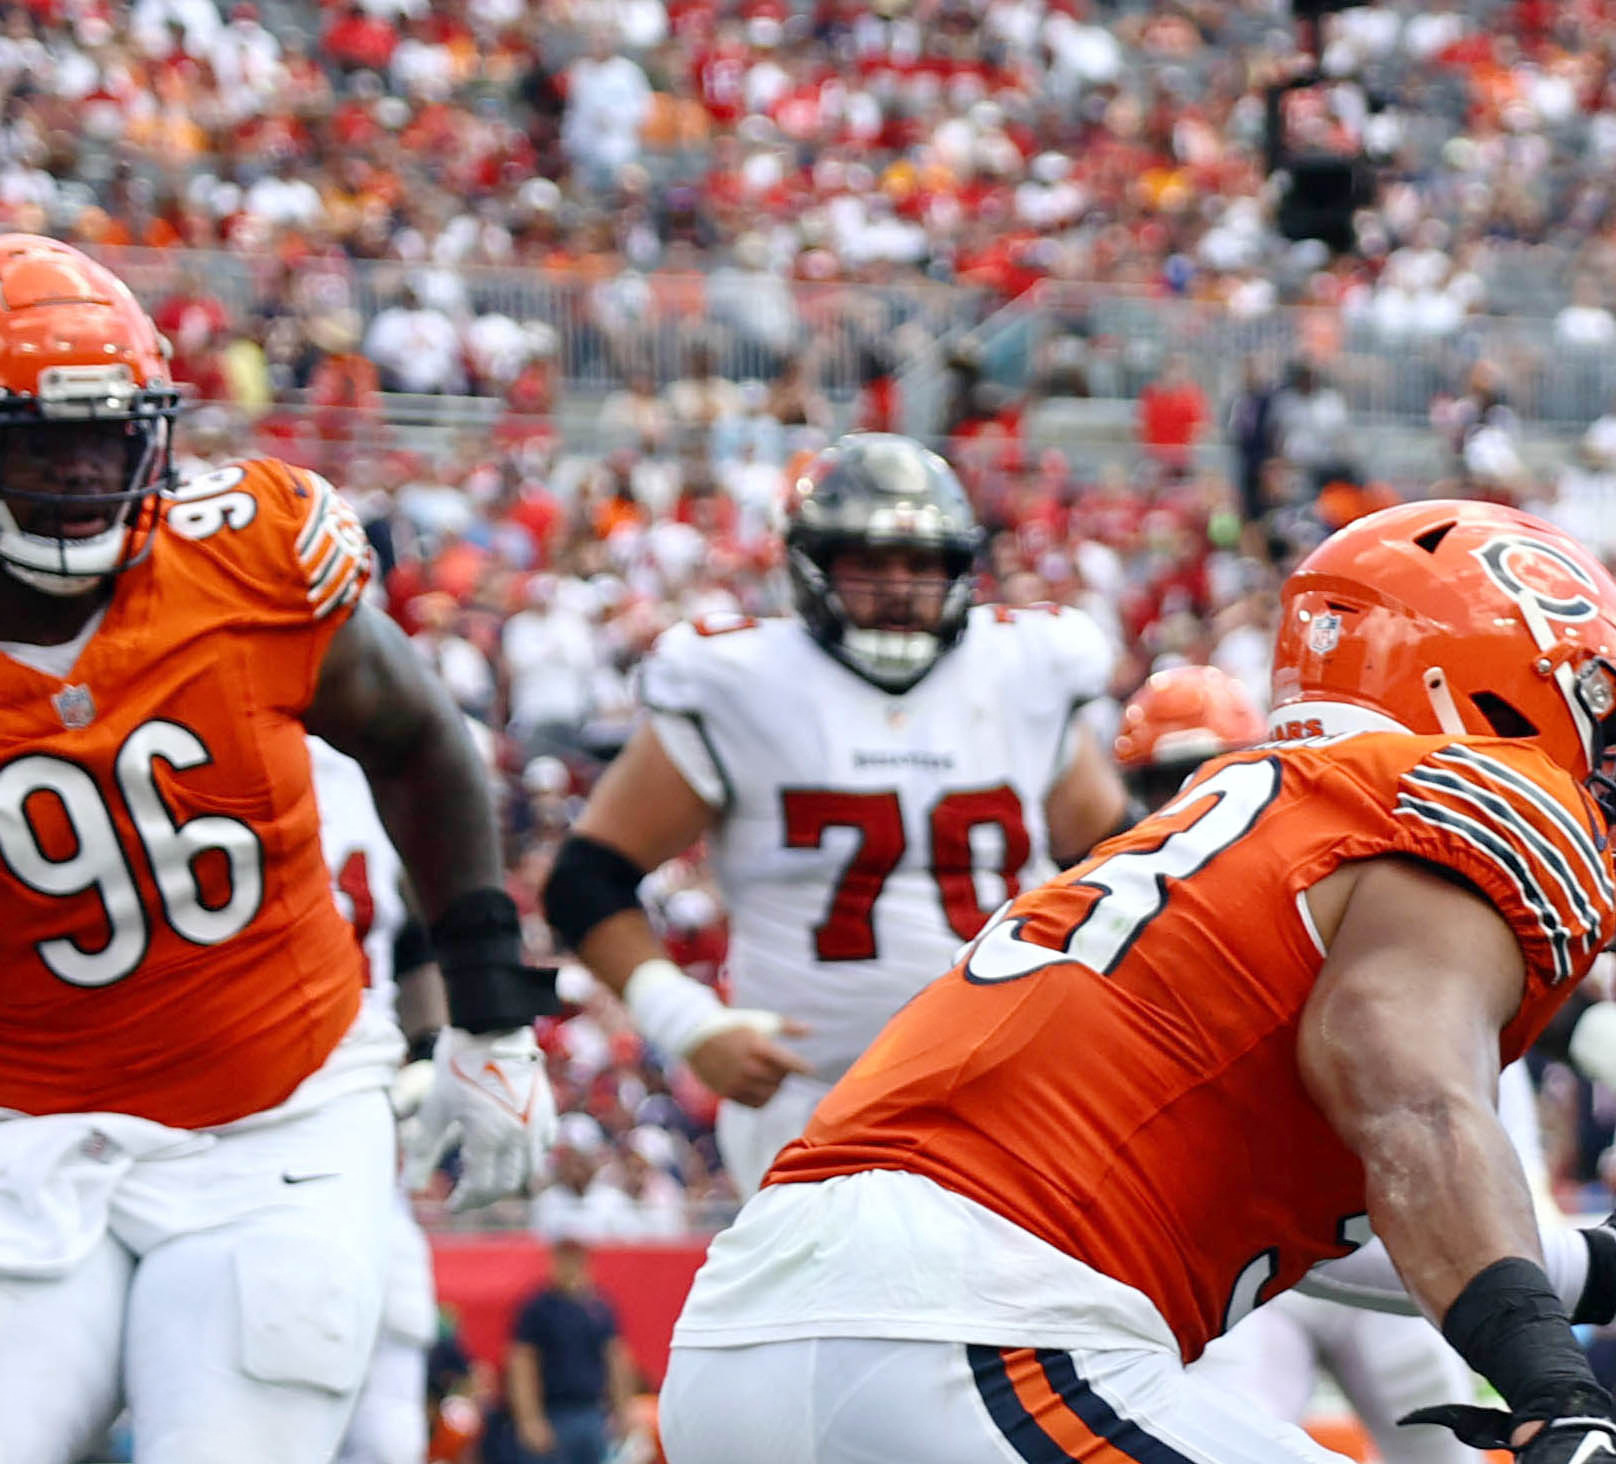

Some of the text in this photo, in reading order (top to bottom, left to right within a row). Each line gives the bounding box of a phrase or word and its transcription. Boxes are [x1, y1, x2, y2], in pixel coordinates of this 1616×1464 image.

[1270, 719, 1324, 741] ARS
[0, 717, 265, 988] 96
[777, 779, 1032, 962] 70
[952, 756, 1273, 986] 3
